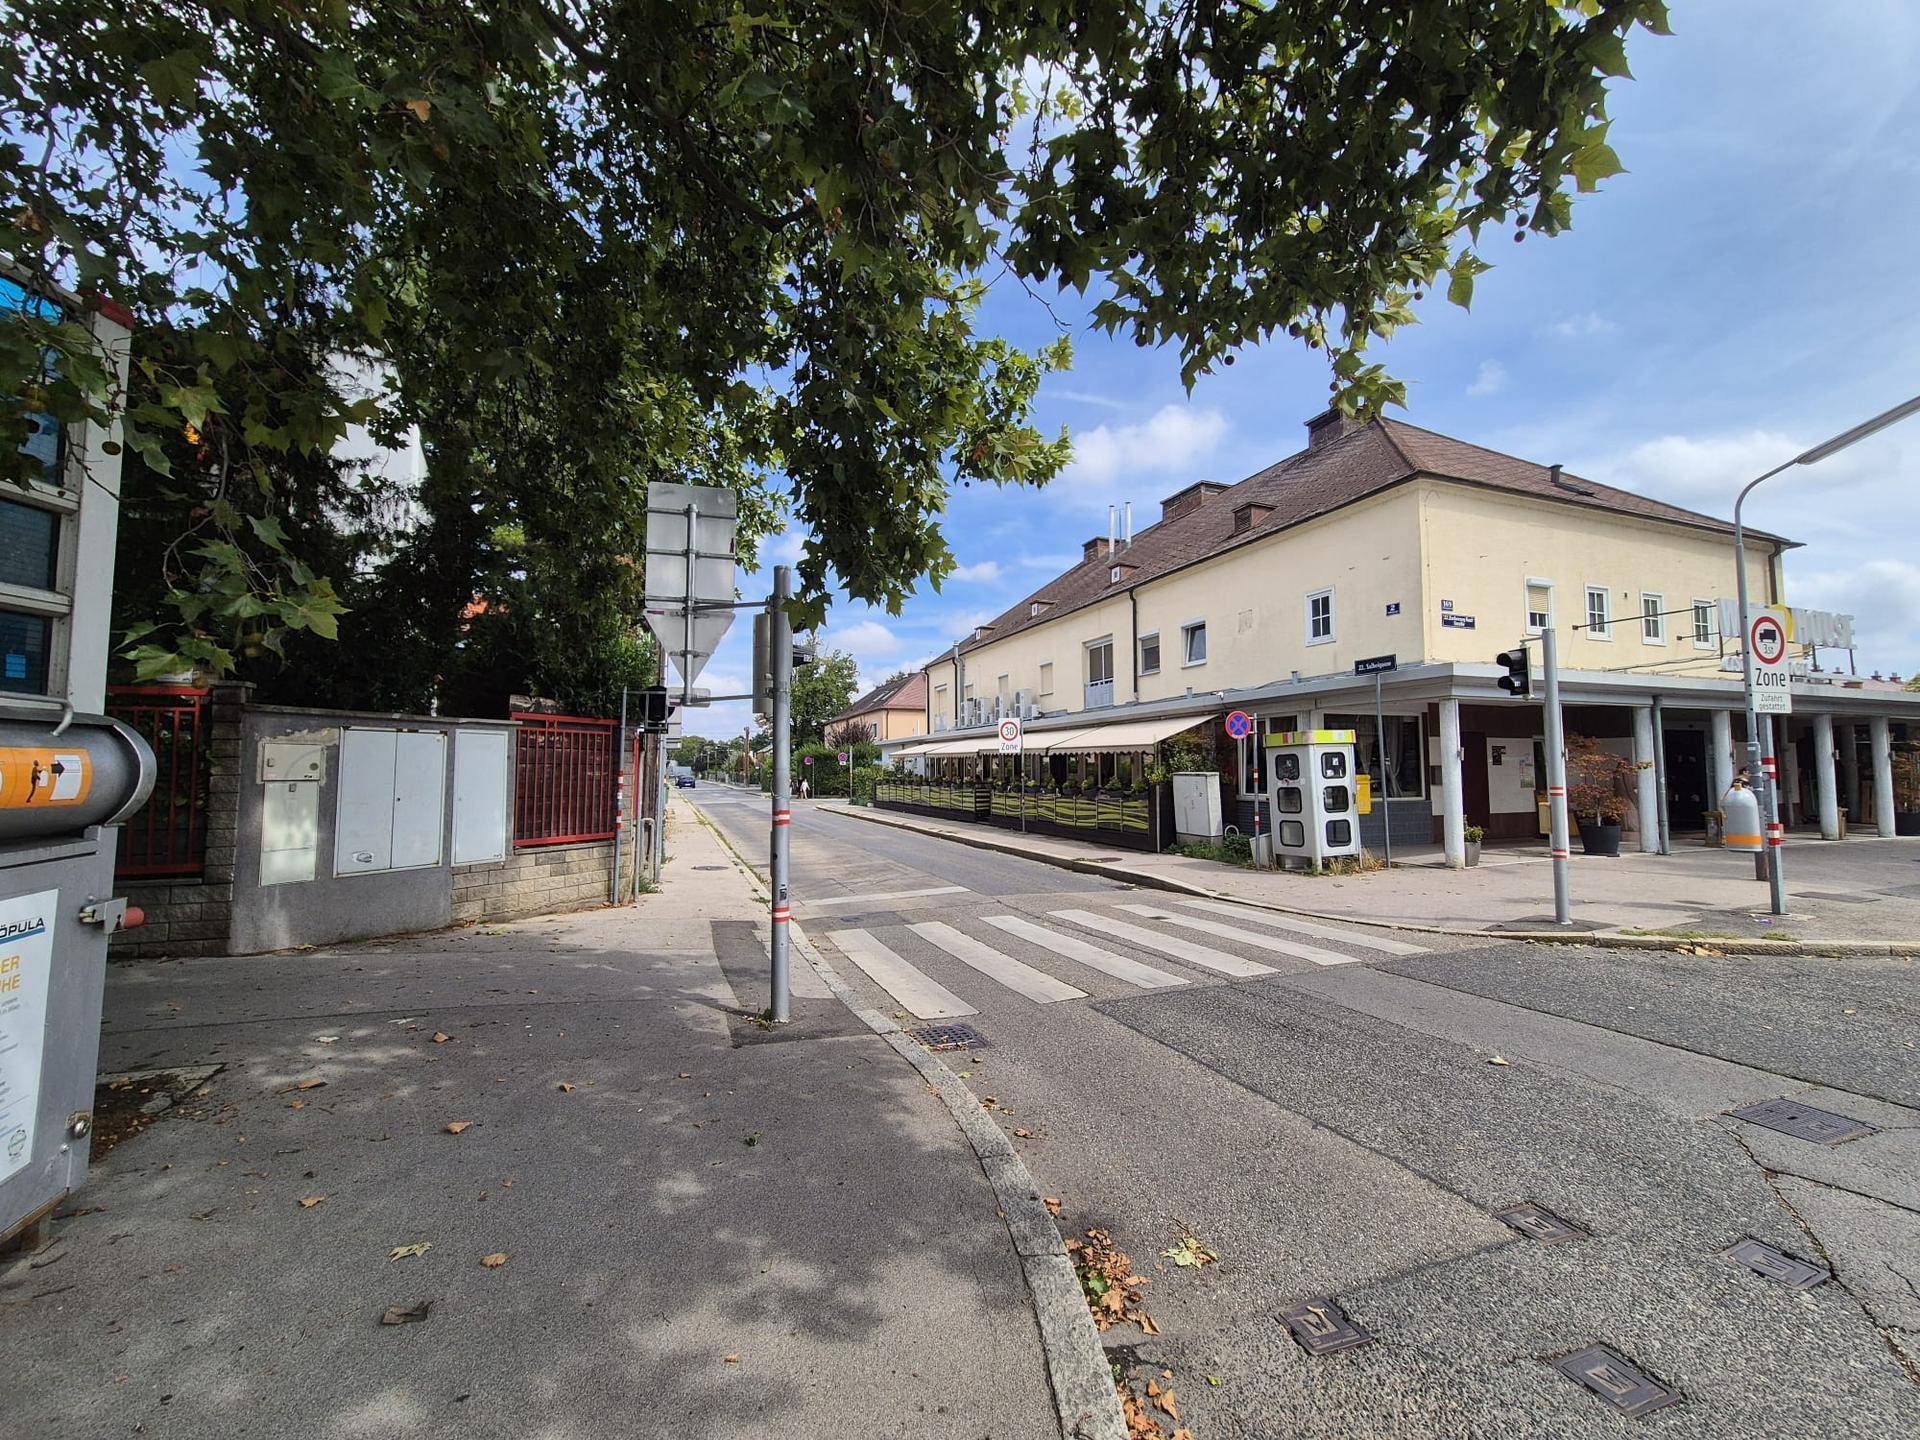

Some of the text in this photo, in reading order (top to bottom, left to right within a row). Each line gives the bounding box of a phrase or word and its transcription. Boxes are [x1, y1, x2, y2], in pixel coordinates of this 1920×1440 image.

[1755, 667, 1786, 687] Zone
[1760, 694, 1783, 702] Zufahrt
[1005, 726, 1014, 736] 30
[1001, 743, 1018, 751] Zone
[0, 955, 20, 974] ER
[0, 974, 21, 993] HE
